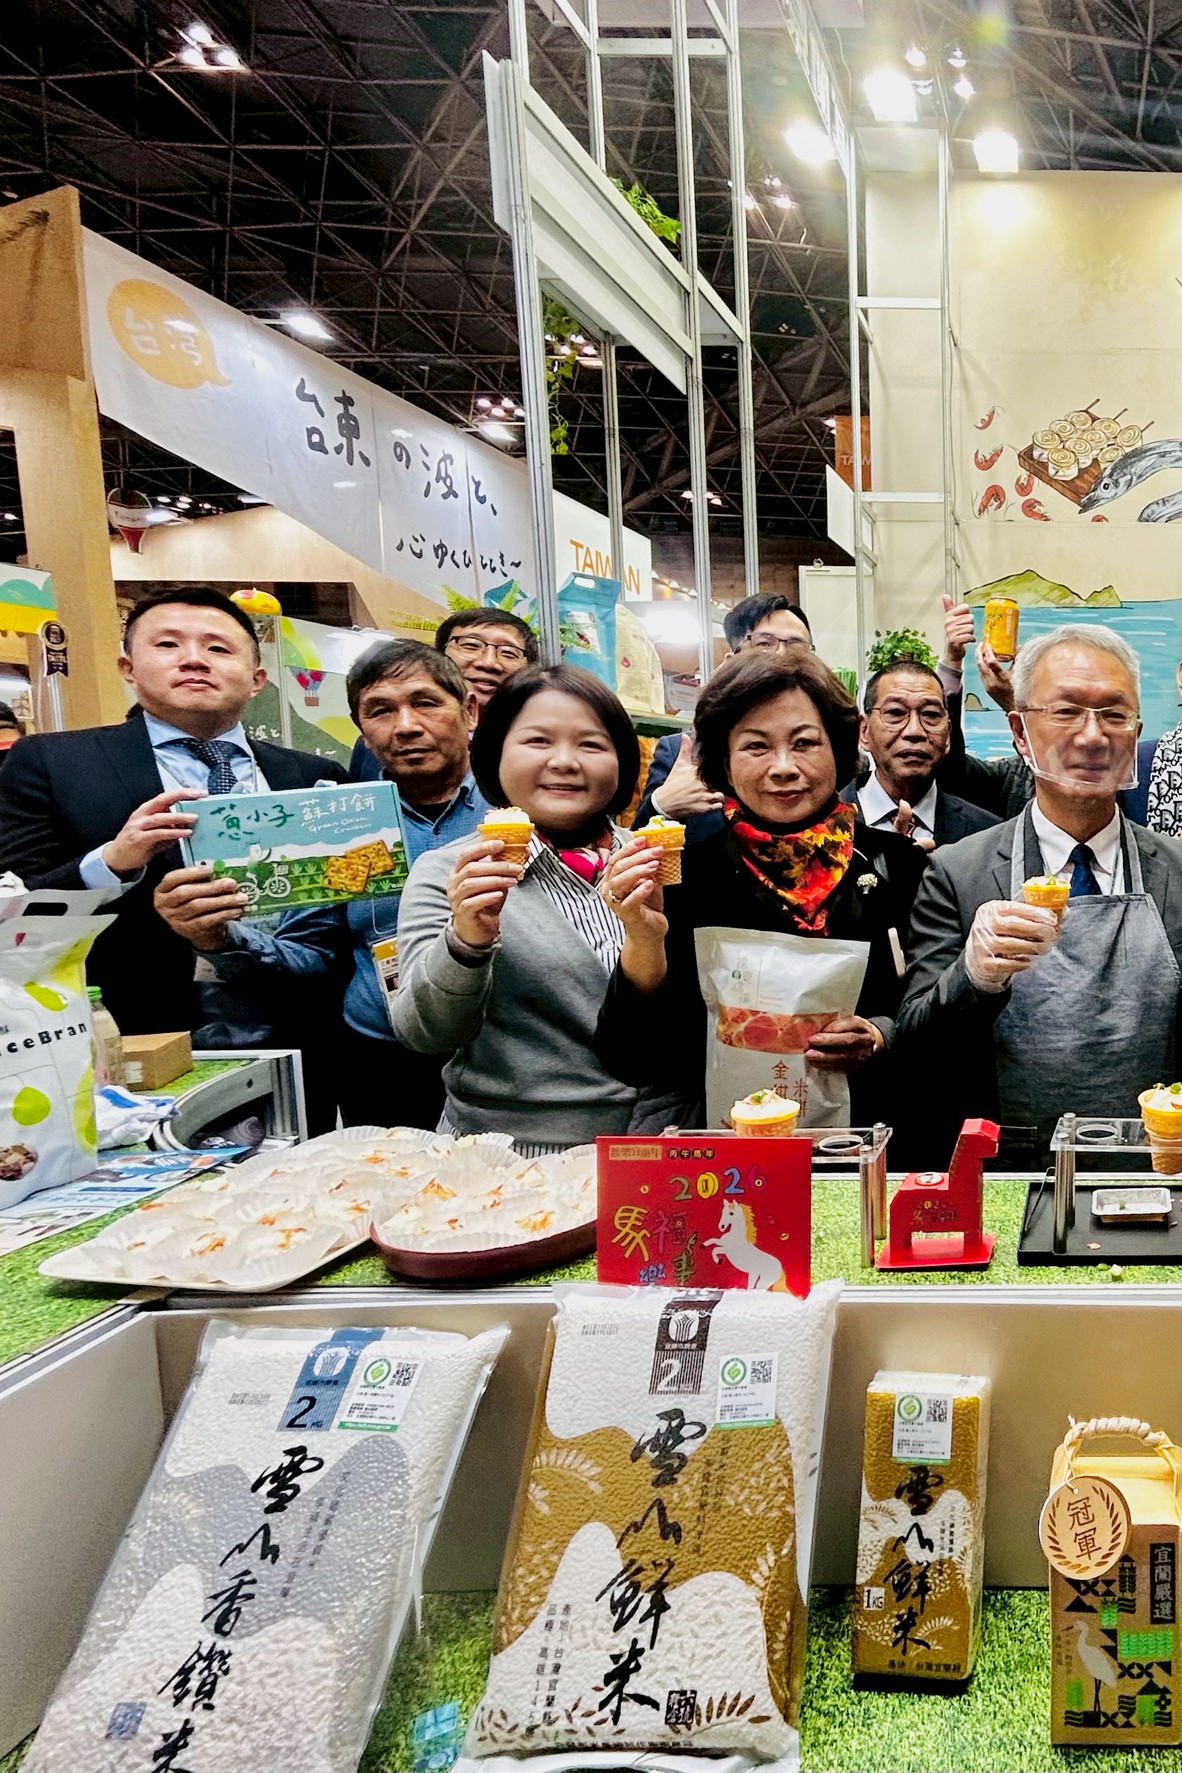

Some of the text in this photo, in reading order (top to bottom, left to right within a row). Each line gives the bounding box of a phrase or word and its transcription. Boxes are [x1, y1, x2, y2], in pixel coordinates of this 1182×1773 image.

[668, 1166, 768, 1201] 2026
[286, 1396, 316, 1429] 2
[1067, 1496, 1102, 1560] 冠軍
[865, 1589, 884, 1609] 1KG
[1153, 1545, 1173, 1620] 宜蘭嚴選
